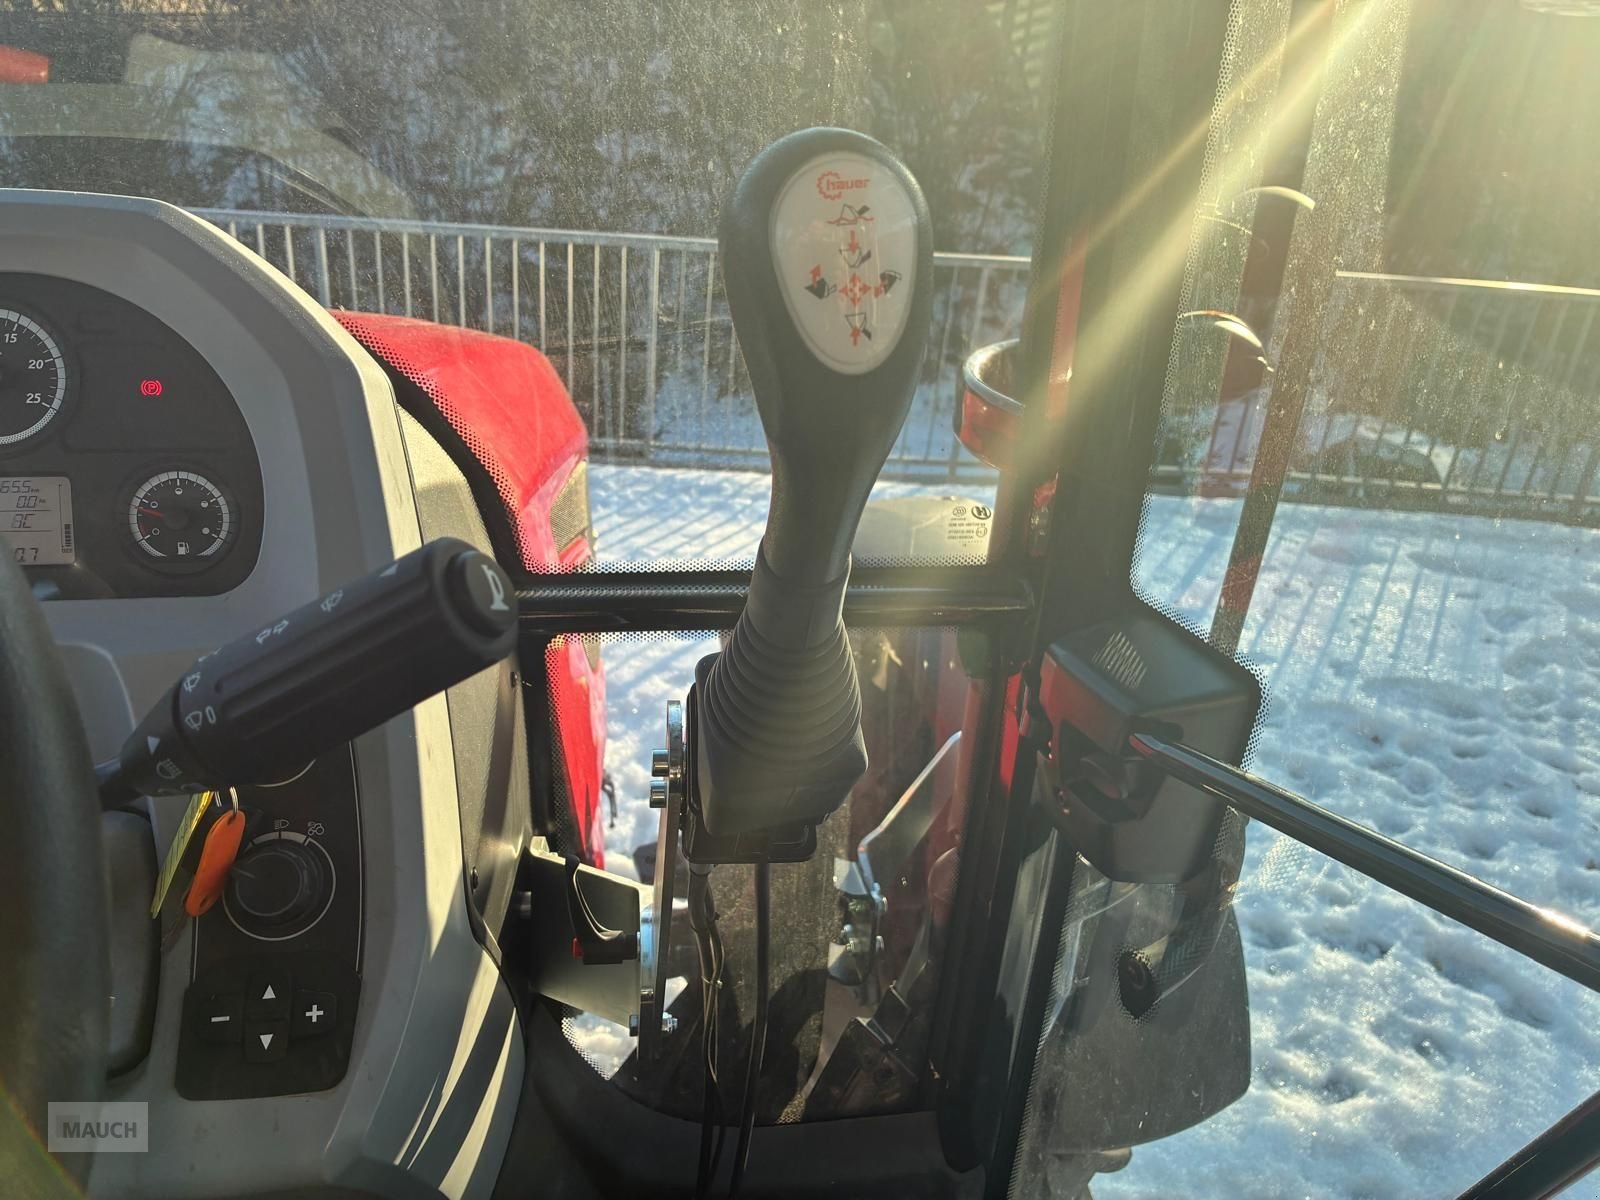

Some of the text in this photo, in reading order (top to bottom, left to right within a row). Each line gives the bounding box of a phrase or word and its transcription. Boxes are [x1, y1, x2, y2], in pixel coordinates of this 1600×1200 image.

[4, 333, 18, 343] 15
[28, 359, 44, 369] 20
[26, 393, 41, 404] 25
